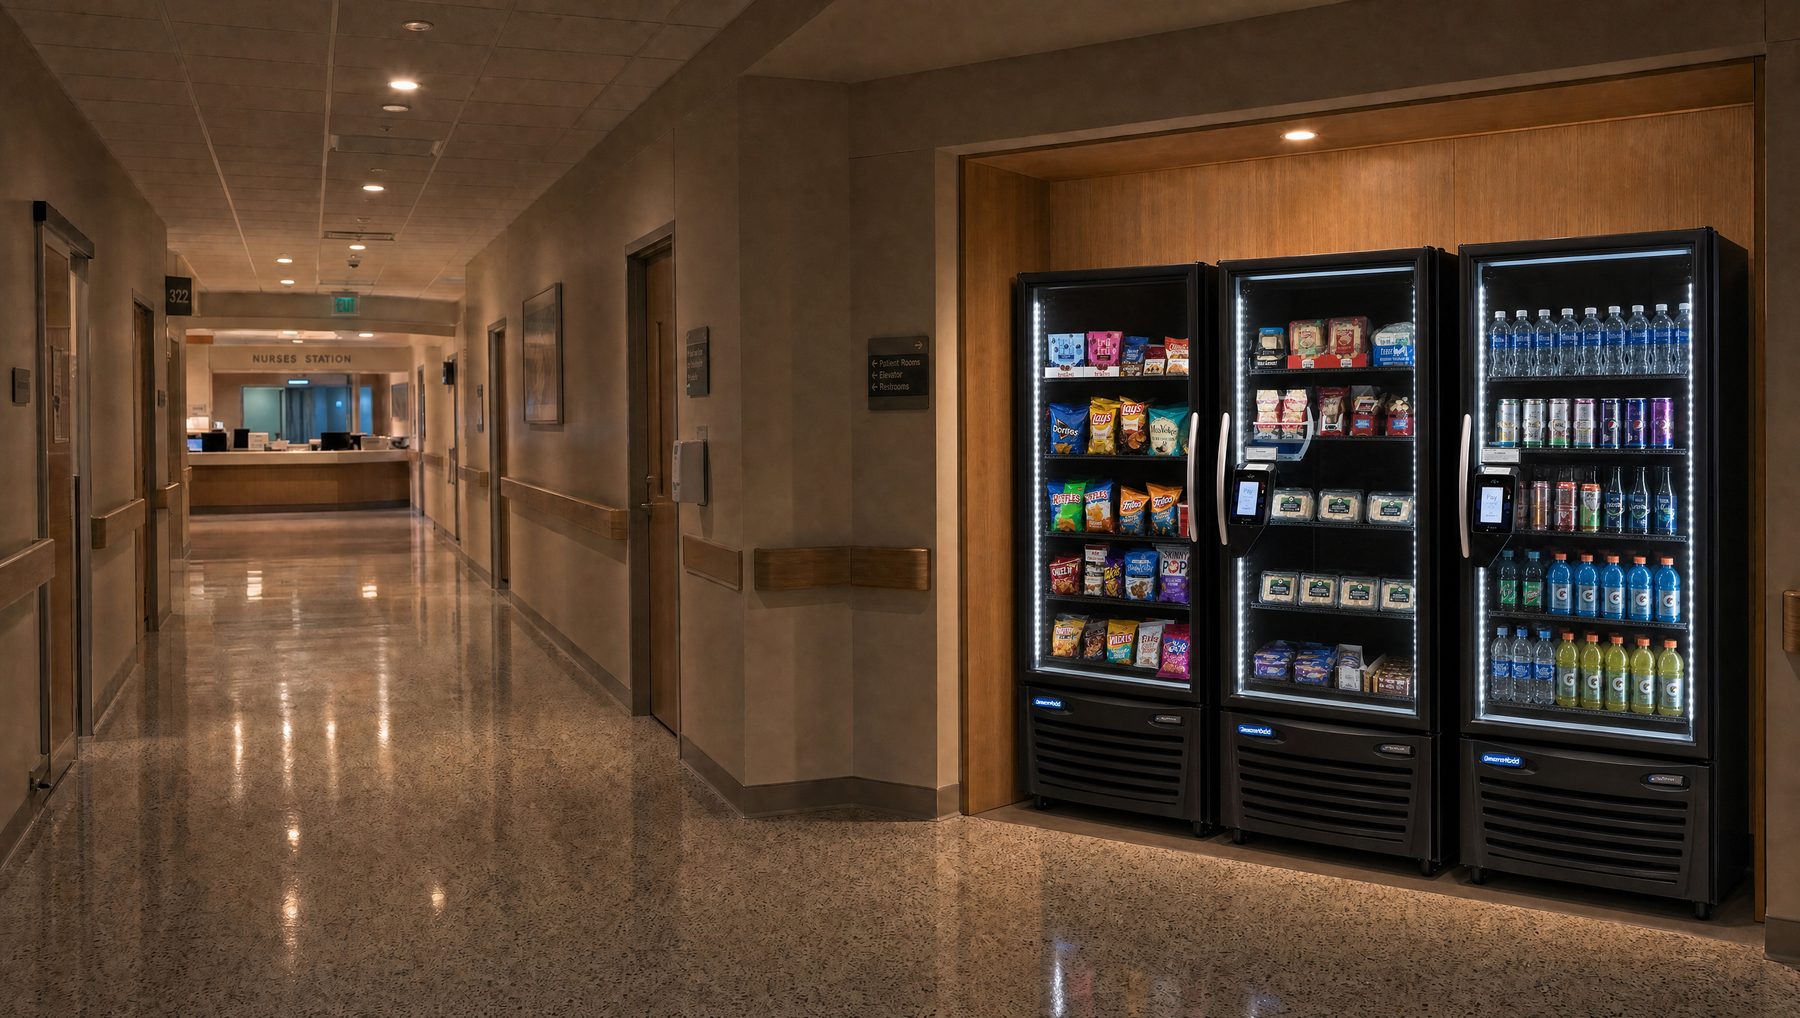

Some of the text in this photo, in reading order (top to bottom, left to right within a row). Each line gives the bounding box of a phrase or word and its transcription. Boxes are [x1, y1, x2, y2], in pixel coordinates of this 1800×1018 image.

[169, 289, 189, 303] 322
[252, 354, 351, 364] NURSES STATION
[879, 358, 921, 368] Patient Rooms
[879, 370, 903, 379] Elevator
[879, 382, 910, 391] Restrooms
[1121, 402, 1143, 416] Lay's
[1092, 412, 1112, 425] Lay's
[1163, 551, 1189, 561] SKINNY
